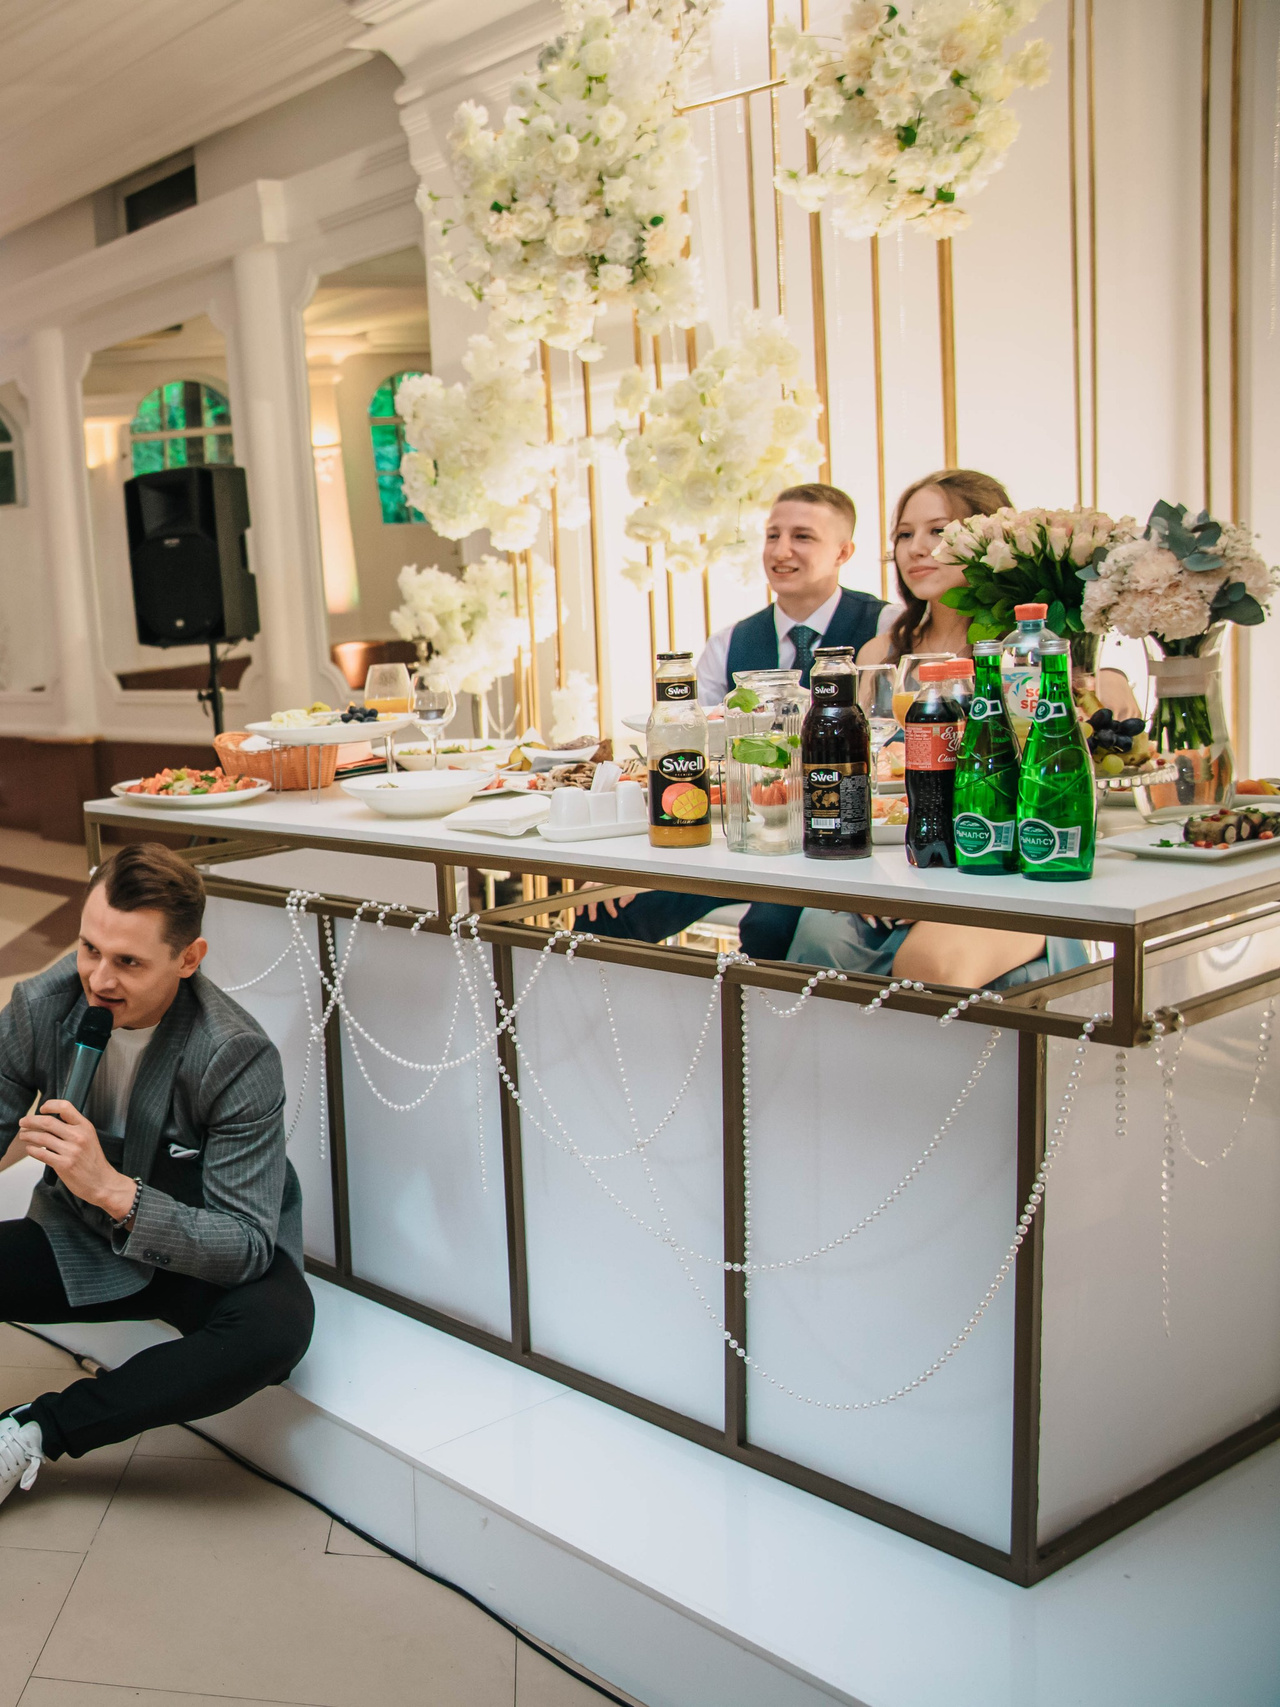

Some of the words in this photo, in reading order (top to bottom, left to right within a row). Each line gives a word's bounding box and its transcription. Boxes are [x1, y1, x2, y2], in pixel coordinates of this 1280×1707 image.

[815, 685, 835, 694] Swell
[662, 755, 703, 772] Swell
[810, 771, 838, 782] Swell
